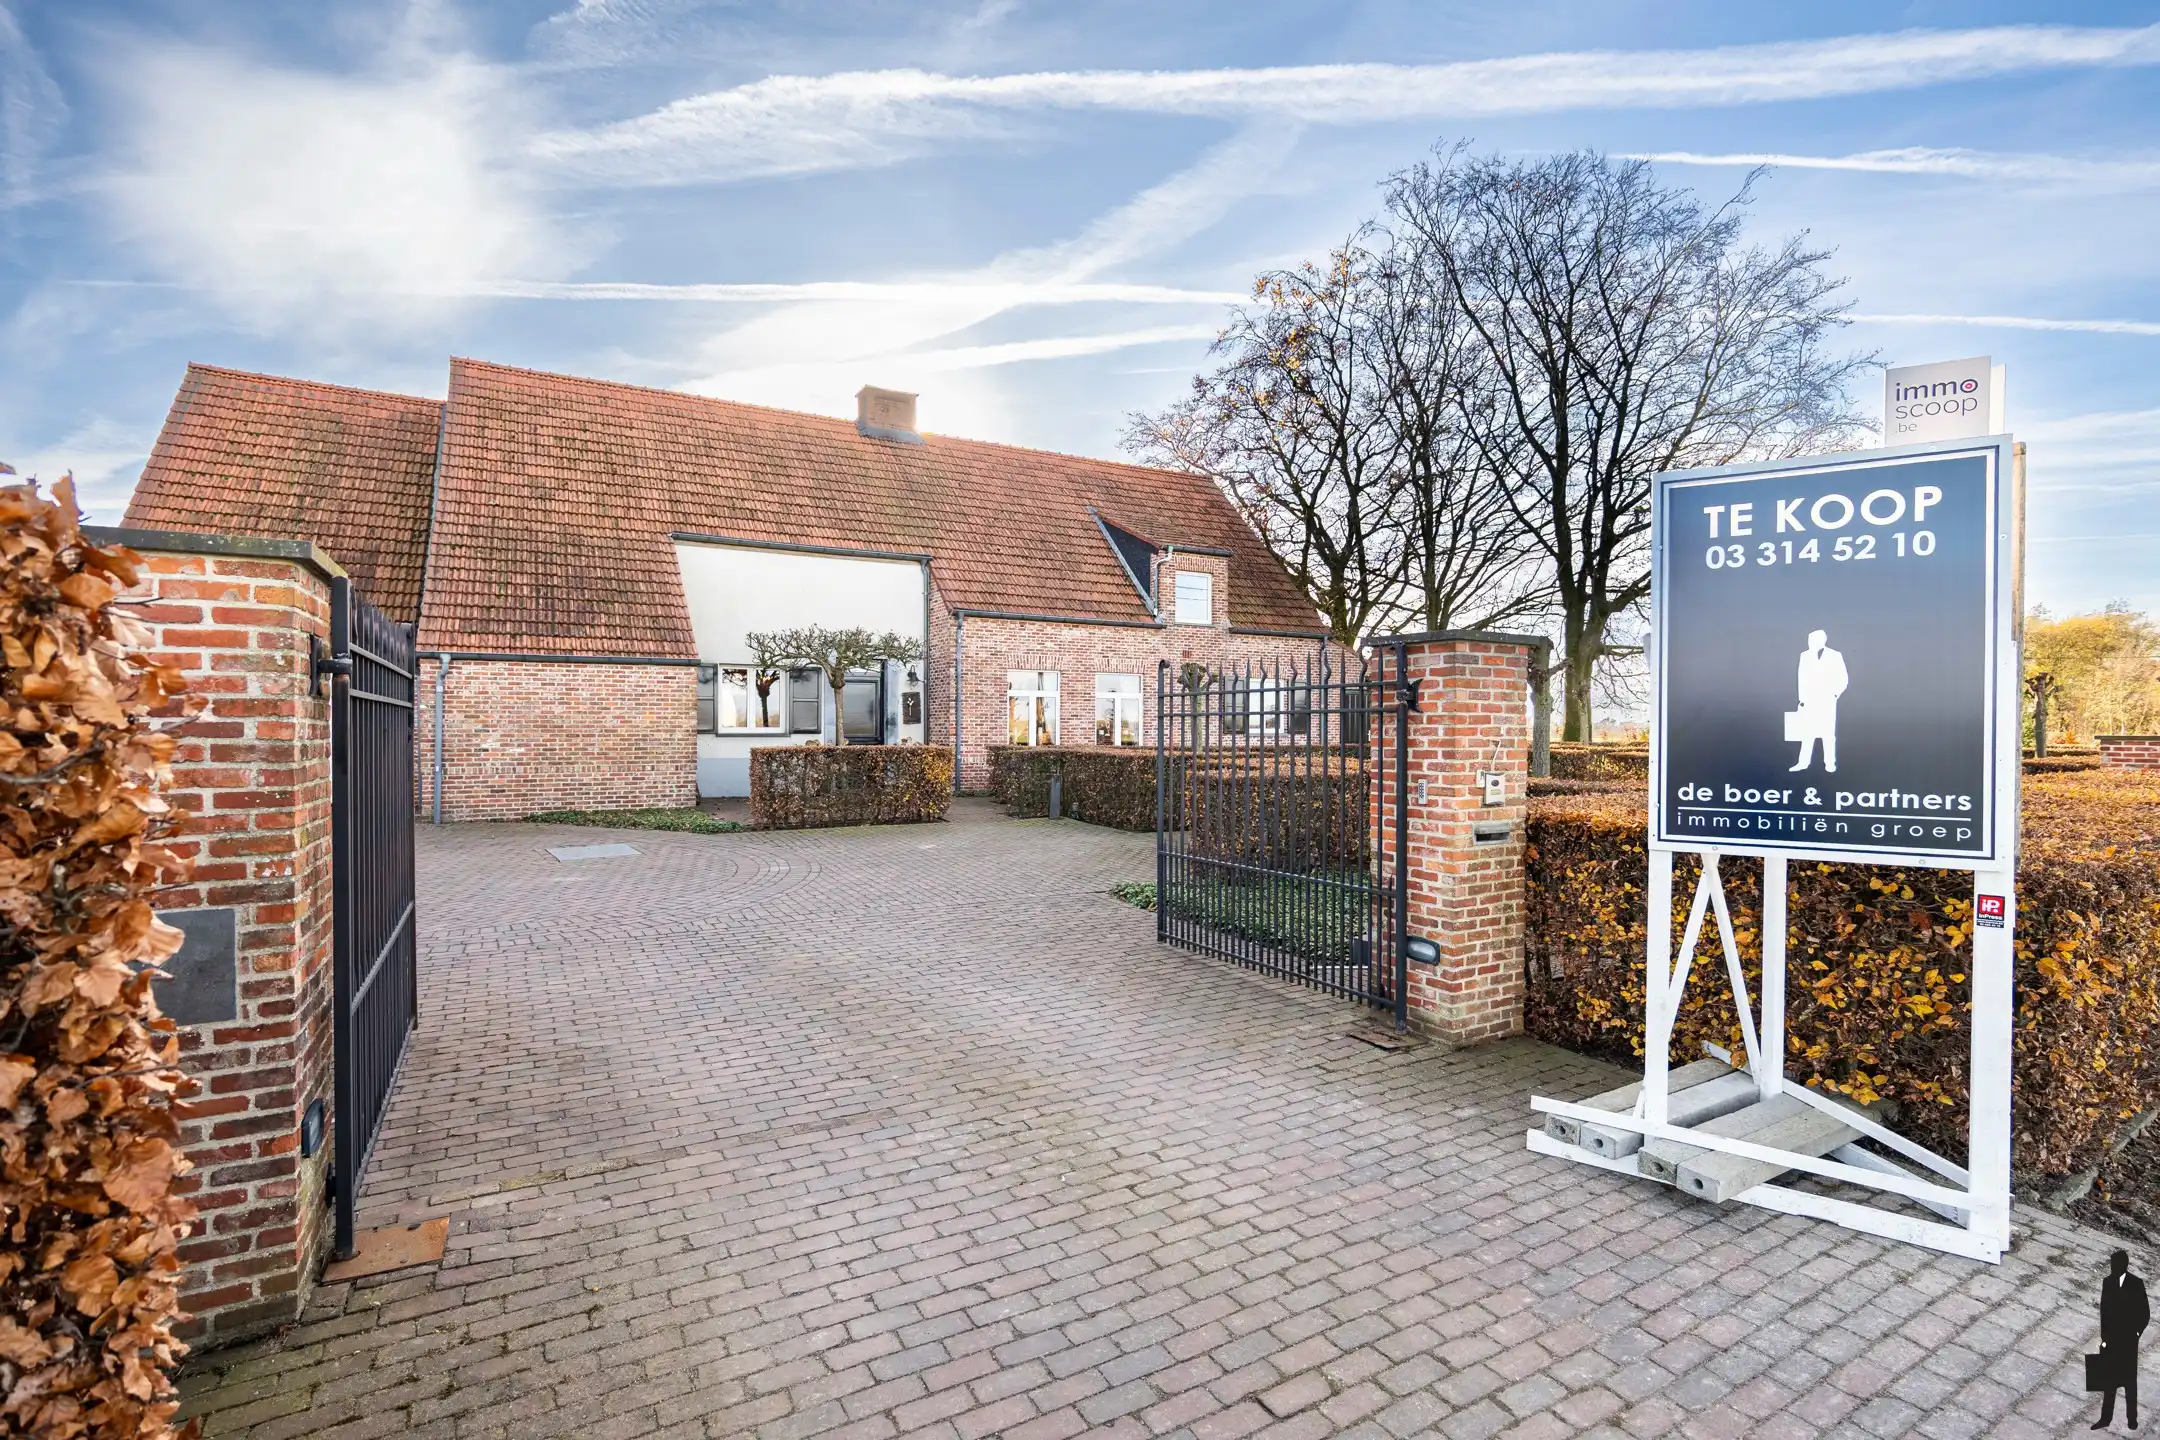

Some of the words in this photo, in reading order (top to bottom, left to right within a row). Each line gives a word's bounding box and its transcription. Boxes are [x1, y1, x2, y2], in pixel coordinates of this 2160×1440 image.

[1896, 379, 1978, 401] immo
[1896, 397, 1978, 419] scoop
[1703, 503, 1753, 539] TE
[1776, 486, 1943, 534] KOOP
[1705, 544, 1746, 570] 03
[1756, 538, 1821, 567] 314
[1831, 534, 1877, 562] 52
[1891, 530, 1937, 557] 10
[1677, 783, 1714, 801] de
[1724, 784, 1793, 805] boer
[1803, 787, 1823, 806] &
[1835, 788, 1972, 811] partners
[1677, 812, 1849, 834] immobiliën
[1870, 823, 1972, 842] groep
